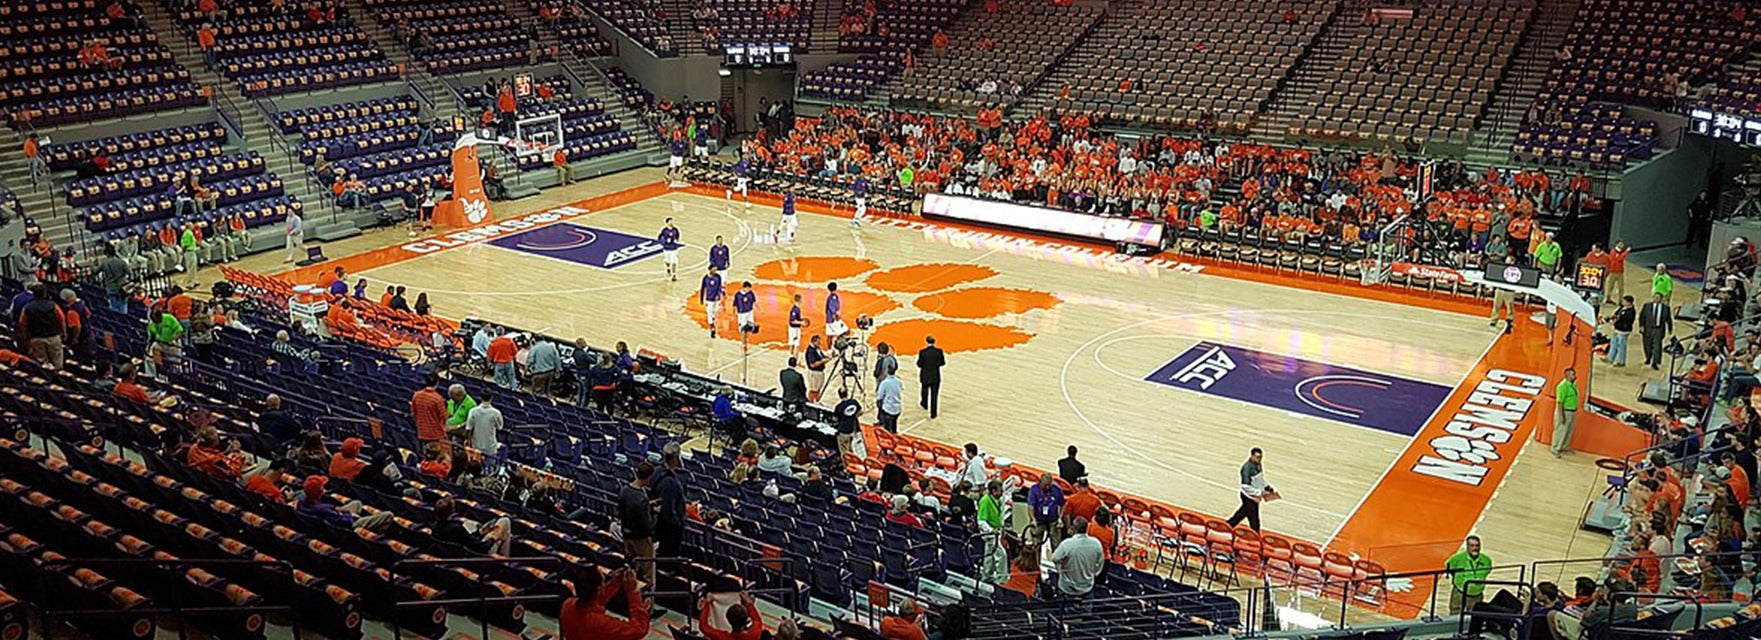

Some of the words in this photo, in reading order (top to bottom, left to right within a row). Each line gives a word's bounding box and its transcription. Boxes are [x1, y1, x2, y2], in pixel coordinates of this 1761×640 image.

[604, 240, 664, 266] ACC
[1580, 264, 1604, 277] 30:04
[1174, 347, 1237, 390] ACC
